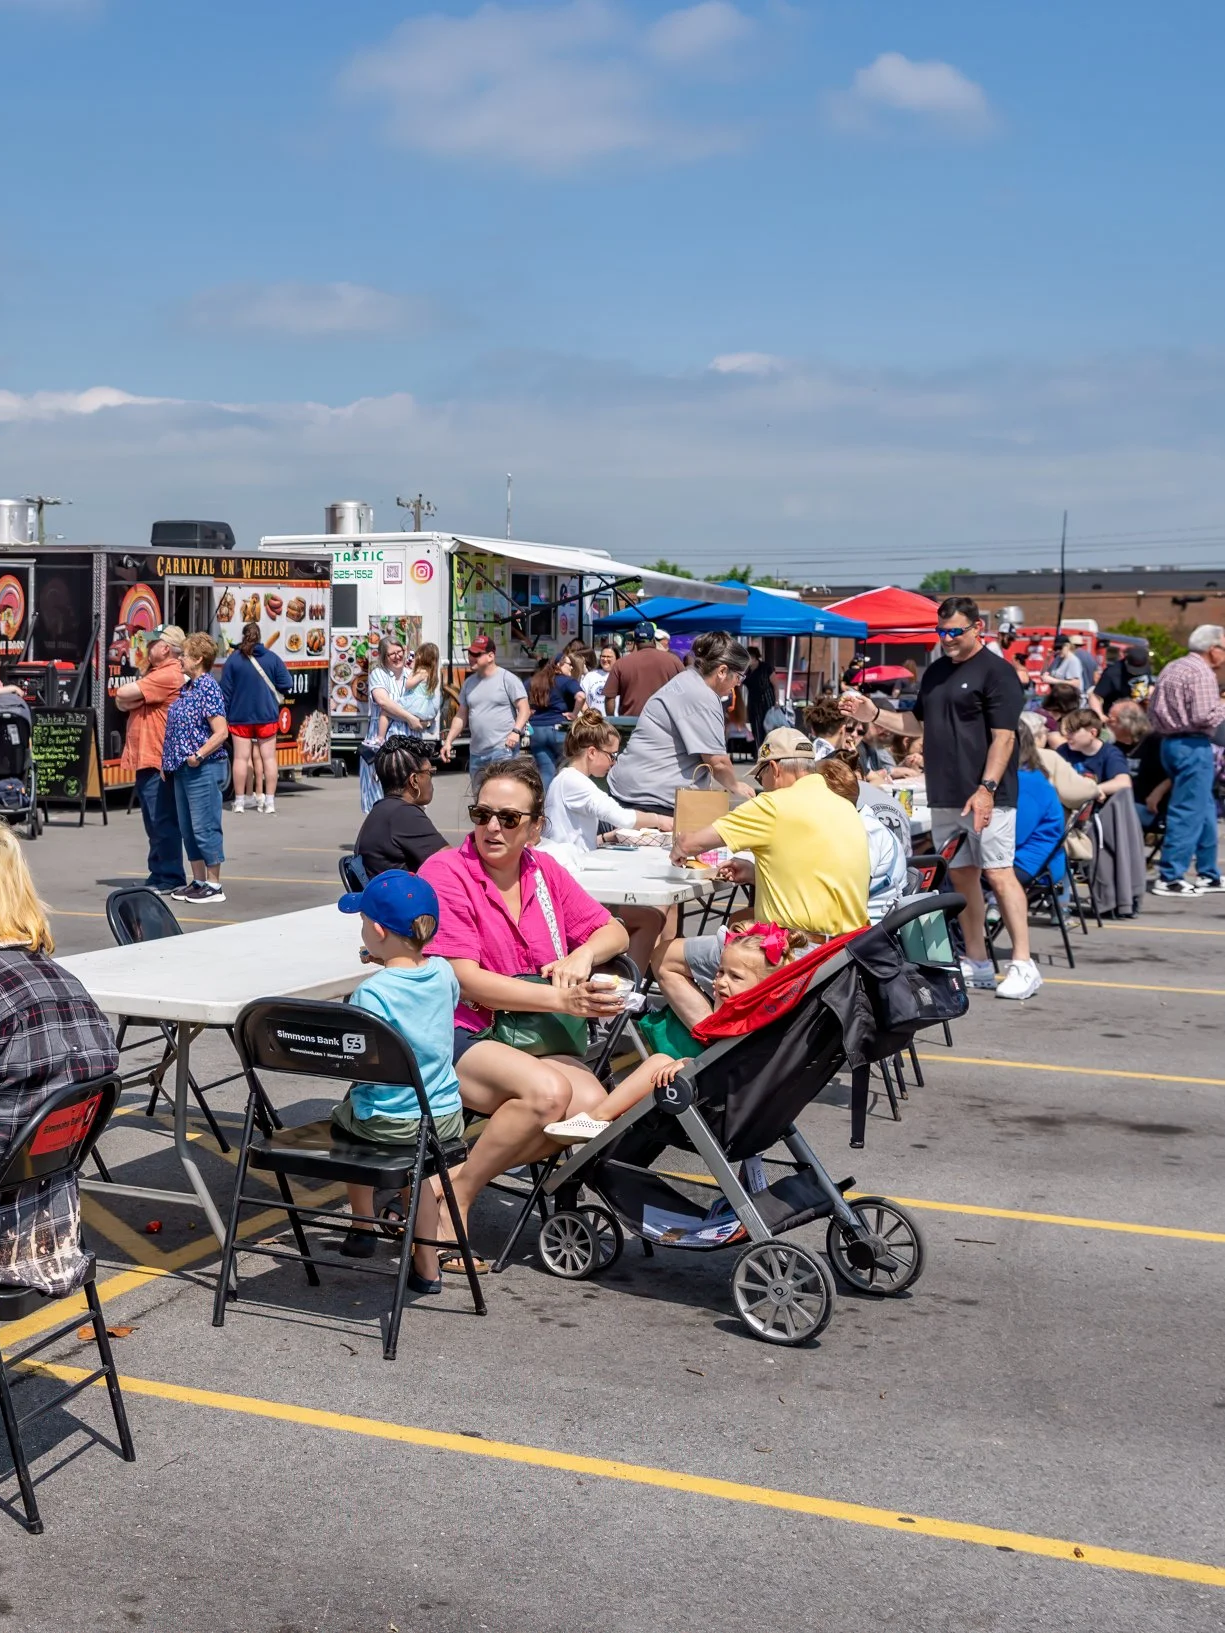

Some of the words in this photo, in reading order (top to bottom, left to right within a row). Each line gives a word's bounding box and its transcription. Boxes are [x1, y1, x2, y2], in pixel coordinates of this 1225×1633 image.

[334, 551, 384, 562] TASTIC
[157, 556, 216, 577] CARNIVAL
[221, 559, 235, 576] ON
[241, 558, 289, 578] WHEELS!
[334, 569, 373, 579] 525-1552
[276, 1029, 316, 1043] Simmons
[316, 1035, 339, 1046] Bank
